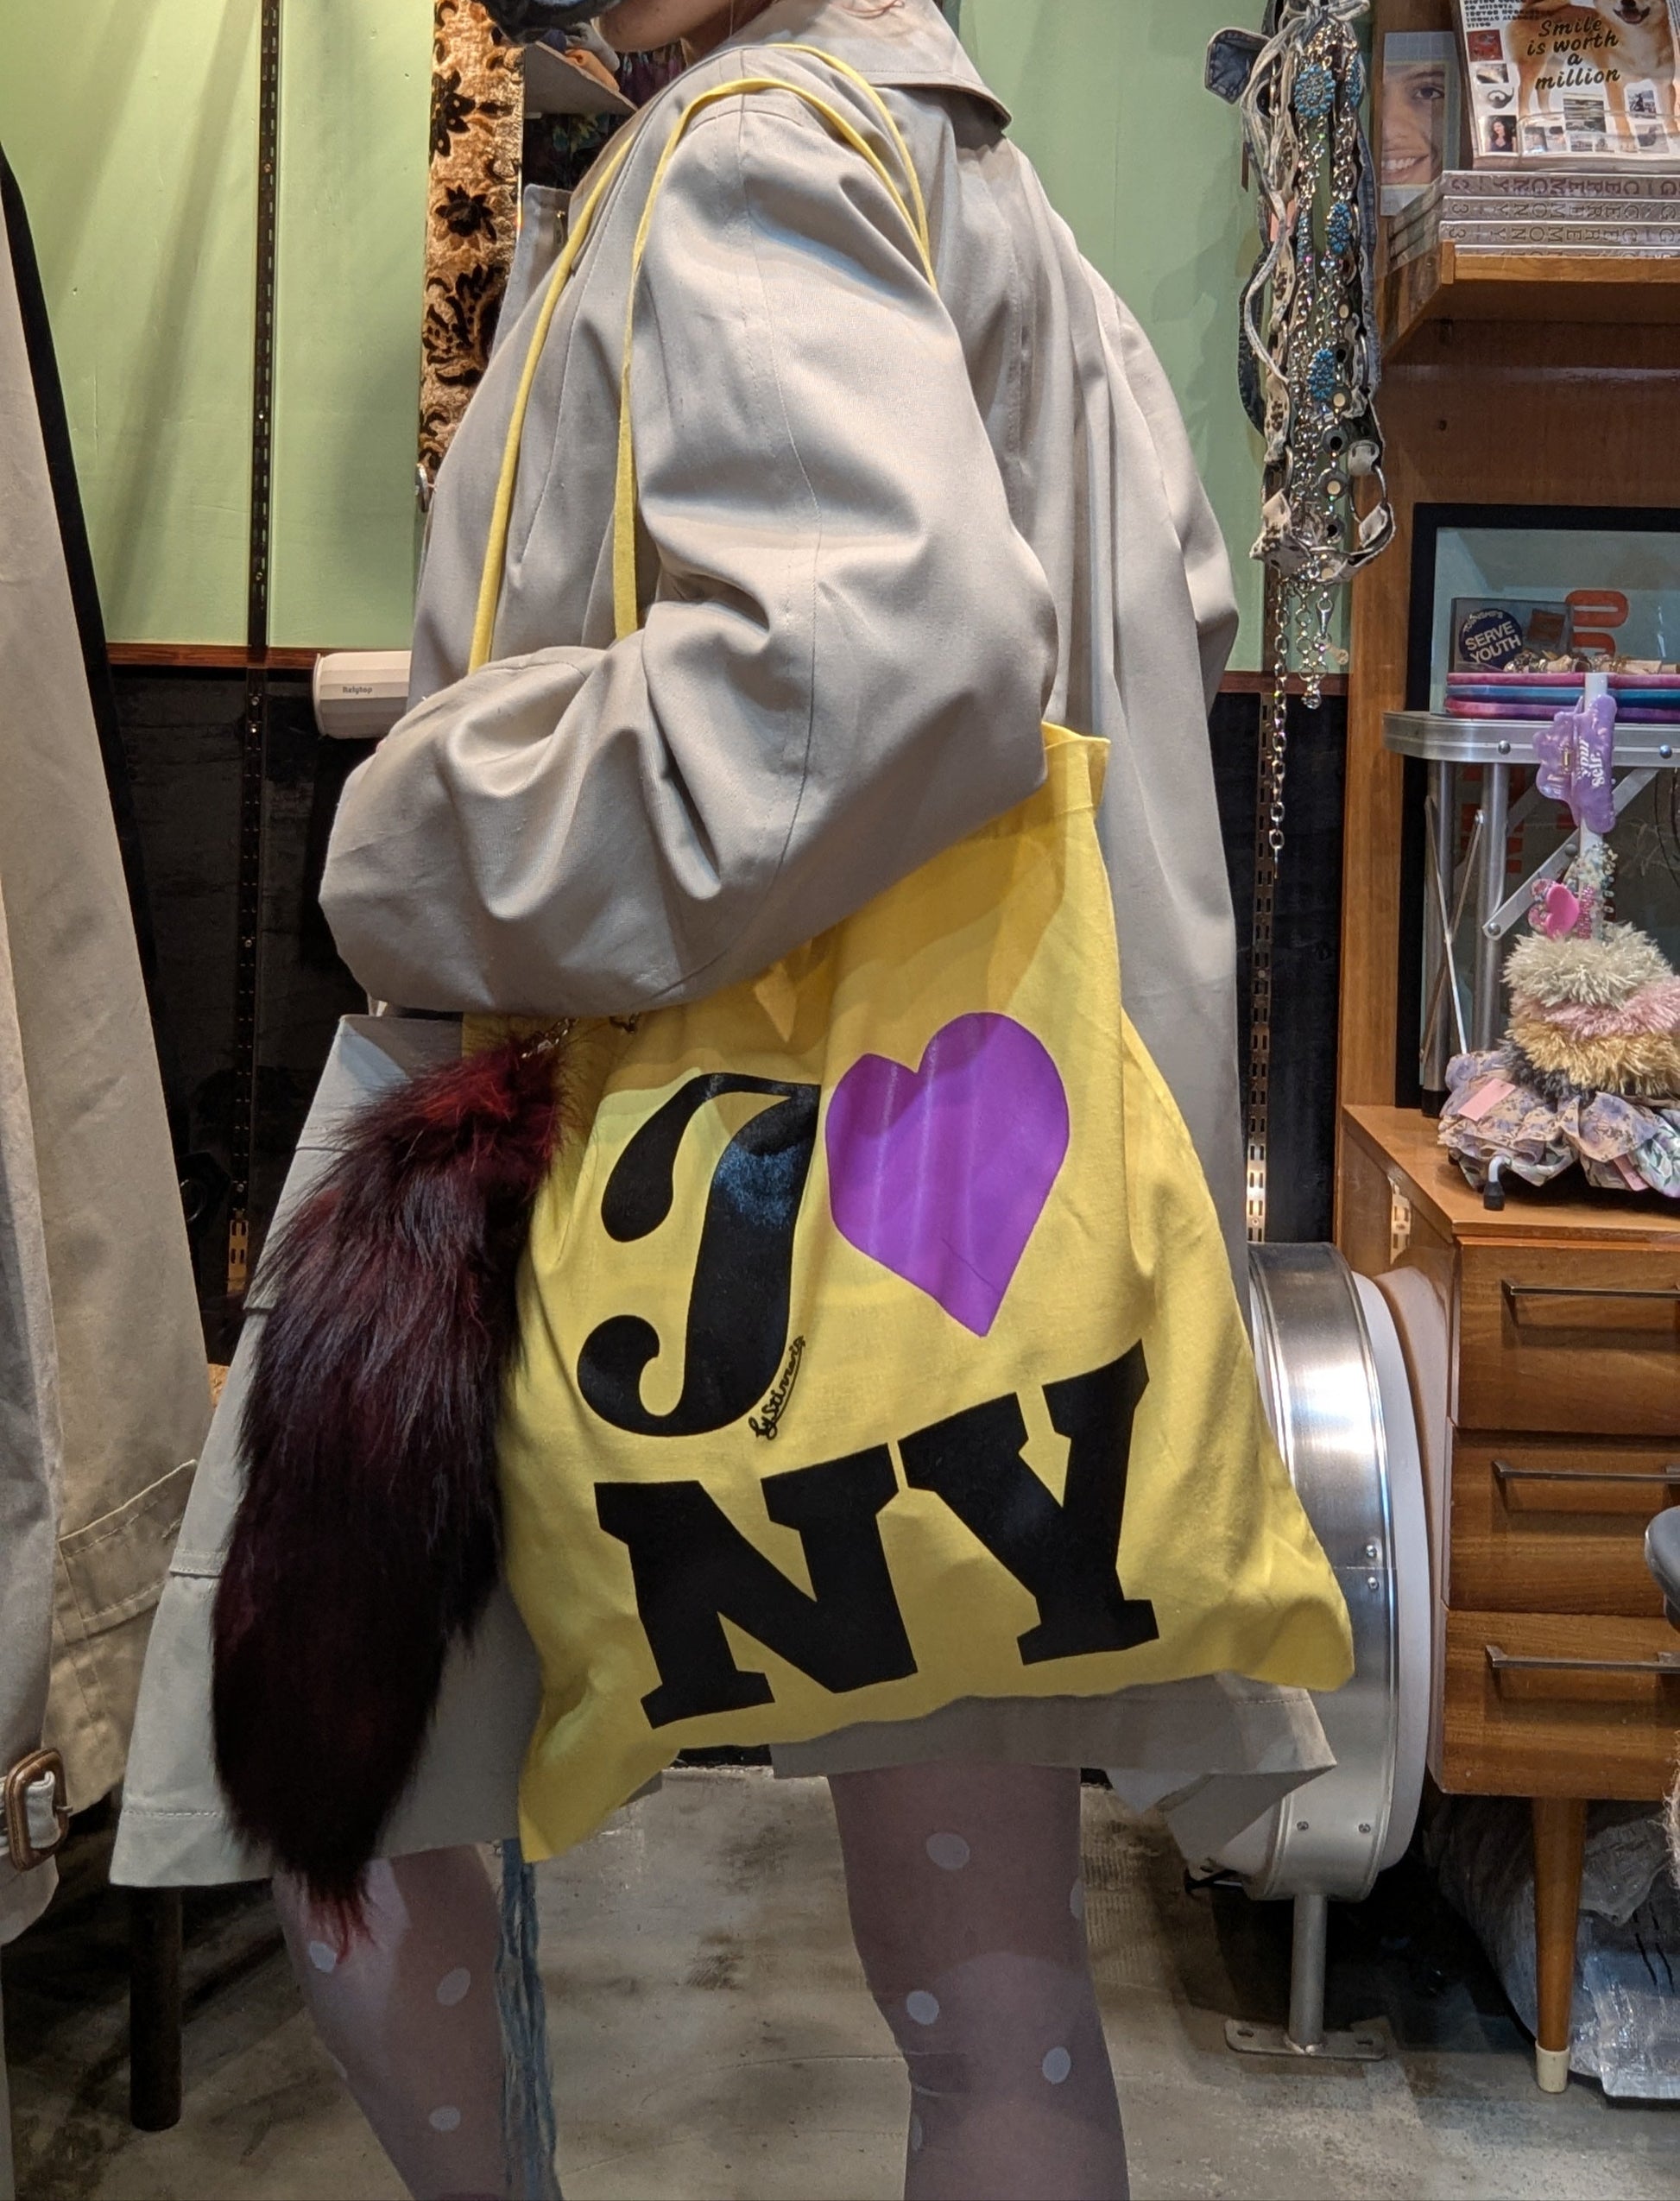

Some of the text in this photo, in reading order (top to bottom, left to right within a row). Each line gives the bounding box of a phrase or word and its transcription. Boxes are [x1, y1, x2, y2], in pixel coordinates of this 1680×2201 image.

[1538, 16, 1602, 37] Smile
[1527, 30, 1619, 56] is worth
[1567, 53, 1583, 66] a
[1535, 68, 1620, 90] million
[1493, 202, 1640, 220] CEREMONY
[1490, 226, 1639, 244] CEREMONY
[1465, 621, 1515, 650] SERVE
[1469, 634, 1521, 663] YOUTH
[594, 1338, 1159, 1730] NY
